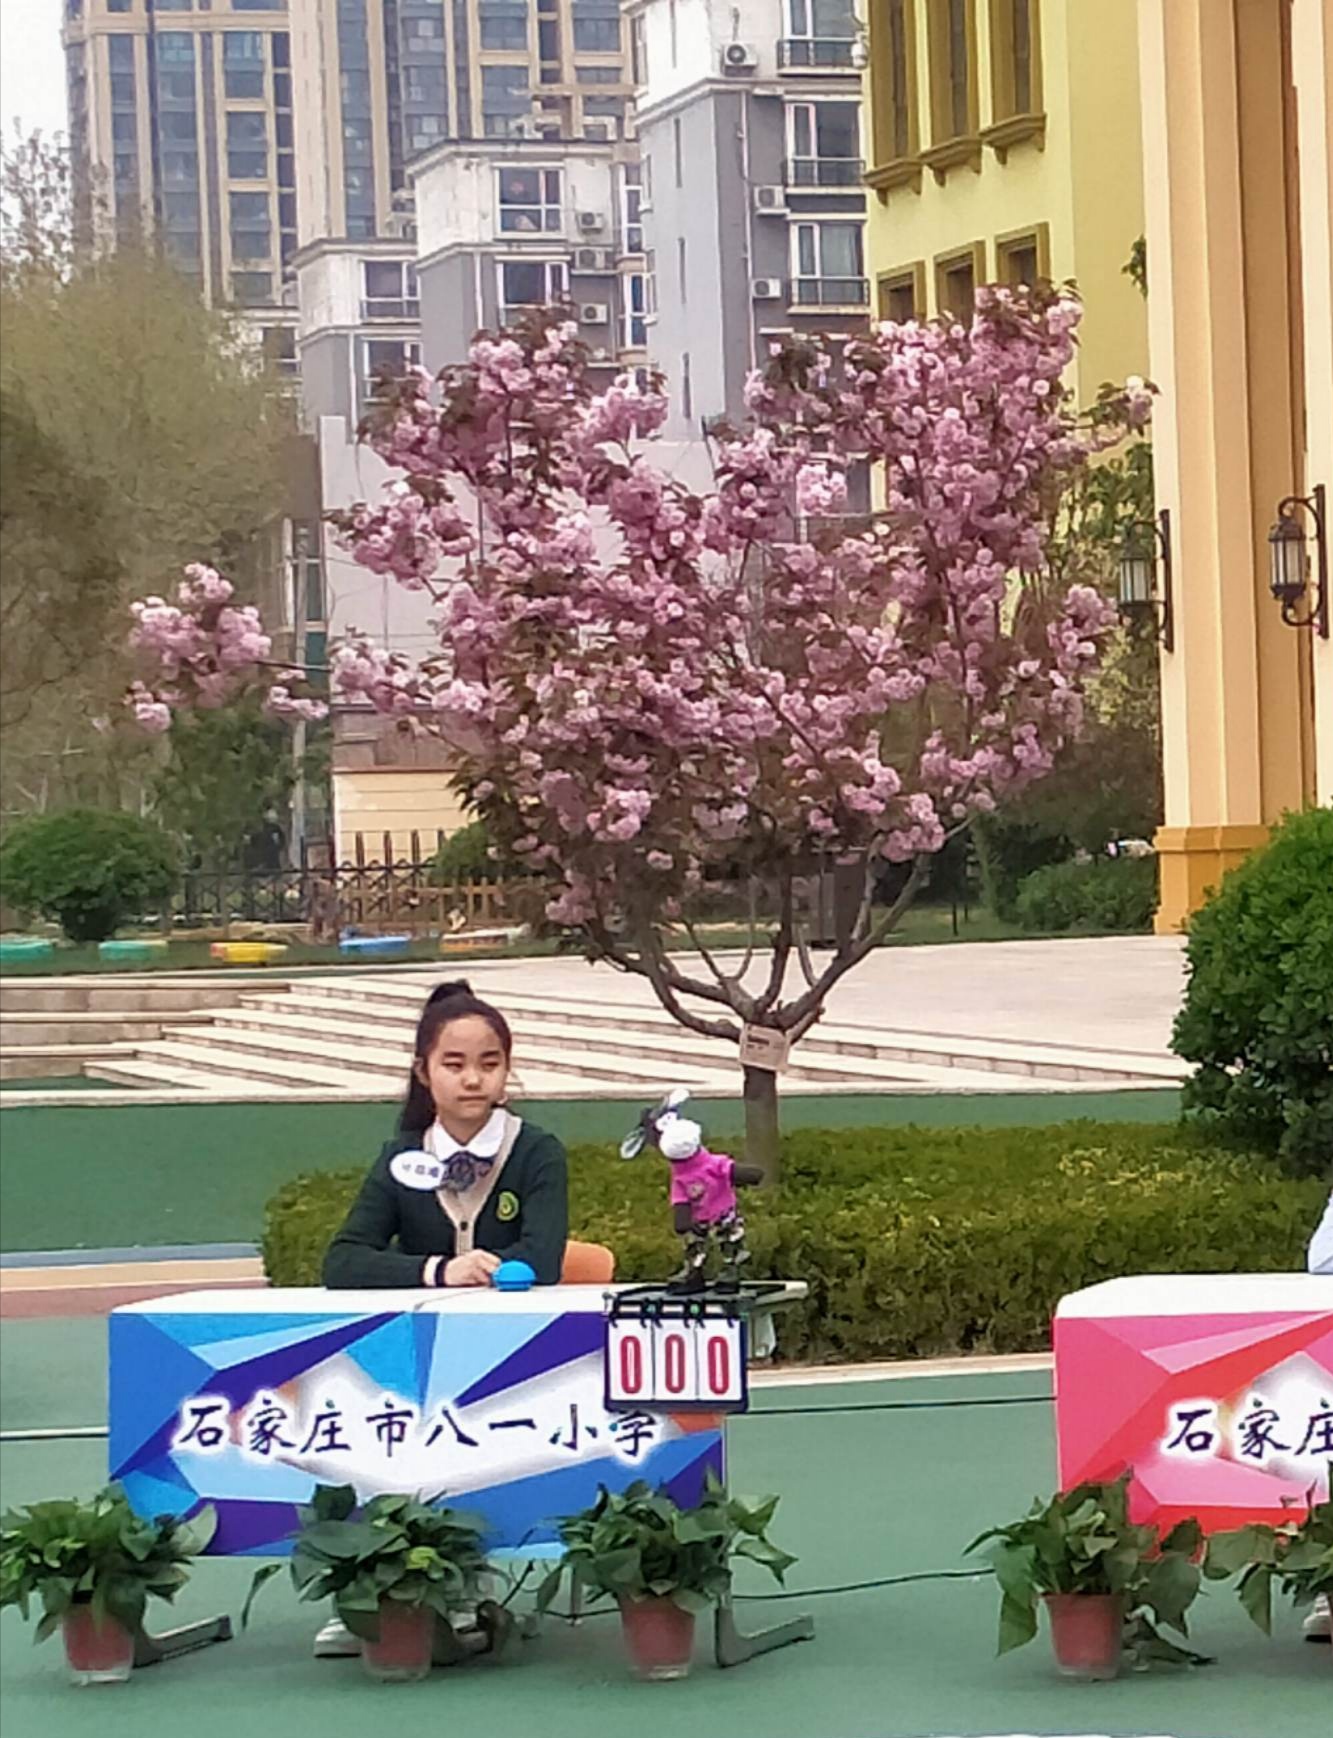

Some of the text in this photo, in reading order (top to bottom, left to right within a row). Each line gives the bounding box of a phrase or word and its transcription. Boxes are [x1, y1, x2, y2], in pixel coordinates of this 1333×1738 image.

[179, 1399, 656, 1457] 石家庄市八一小学
